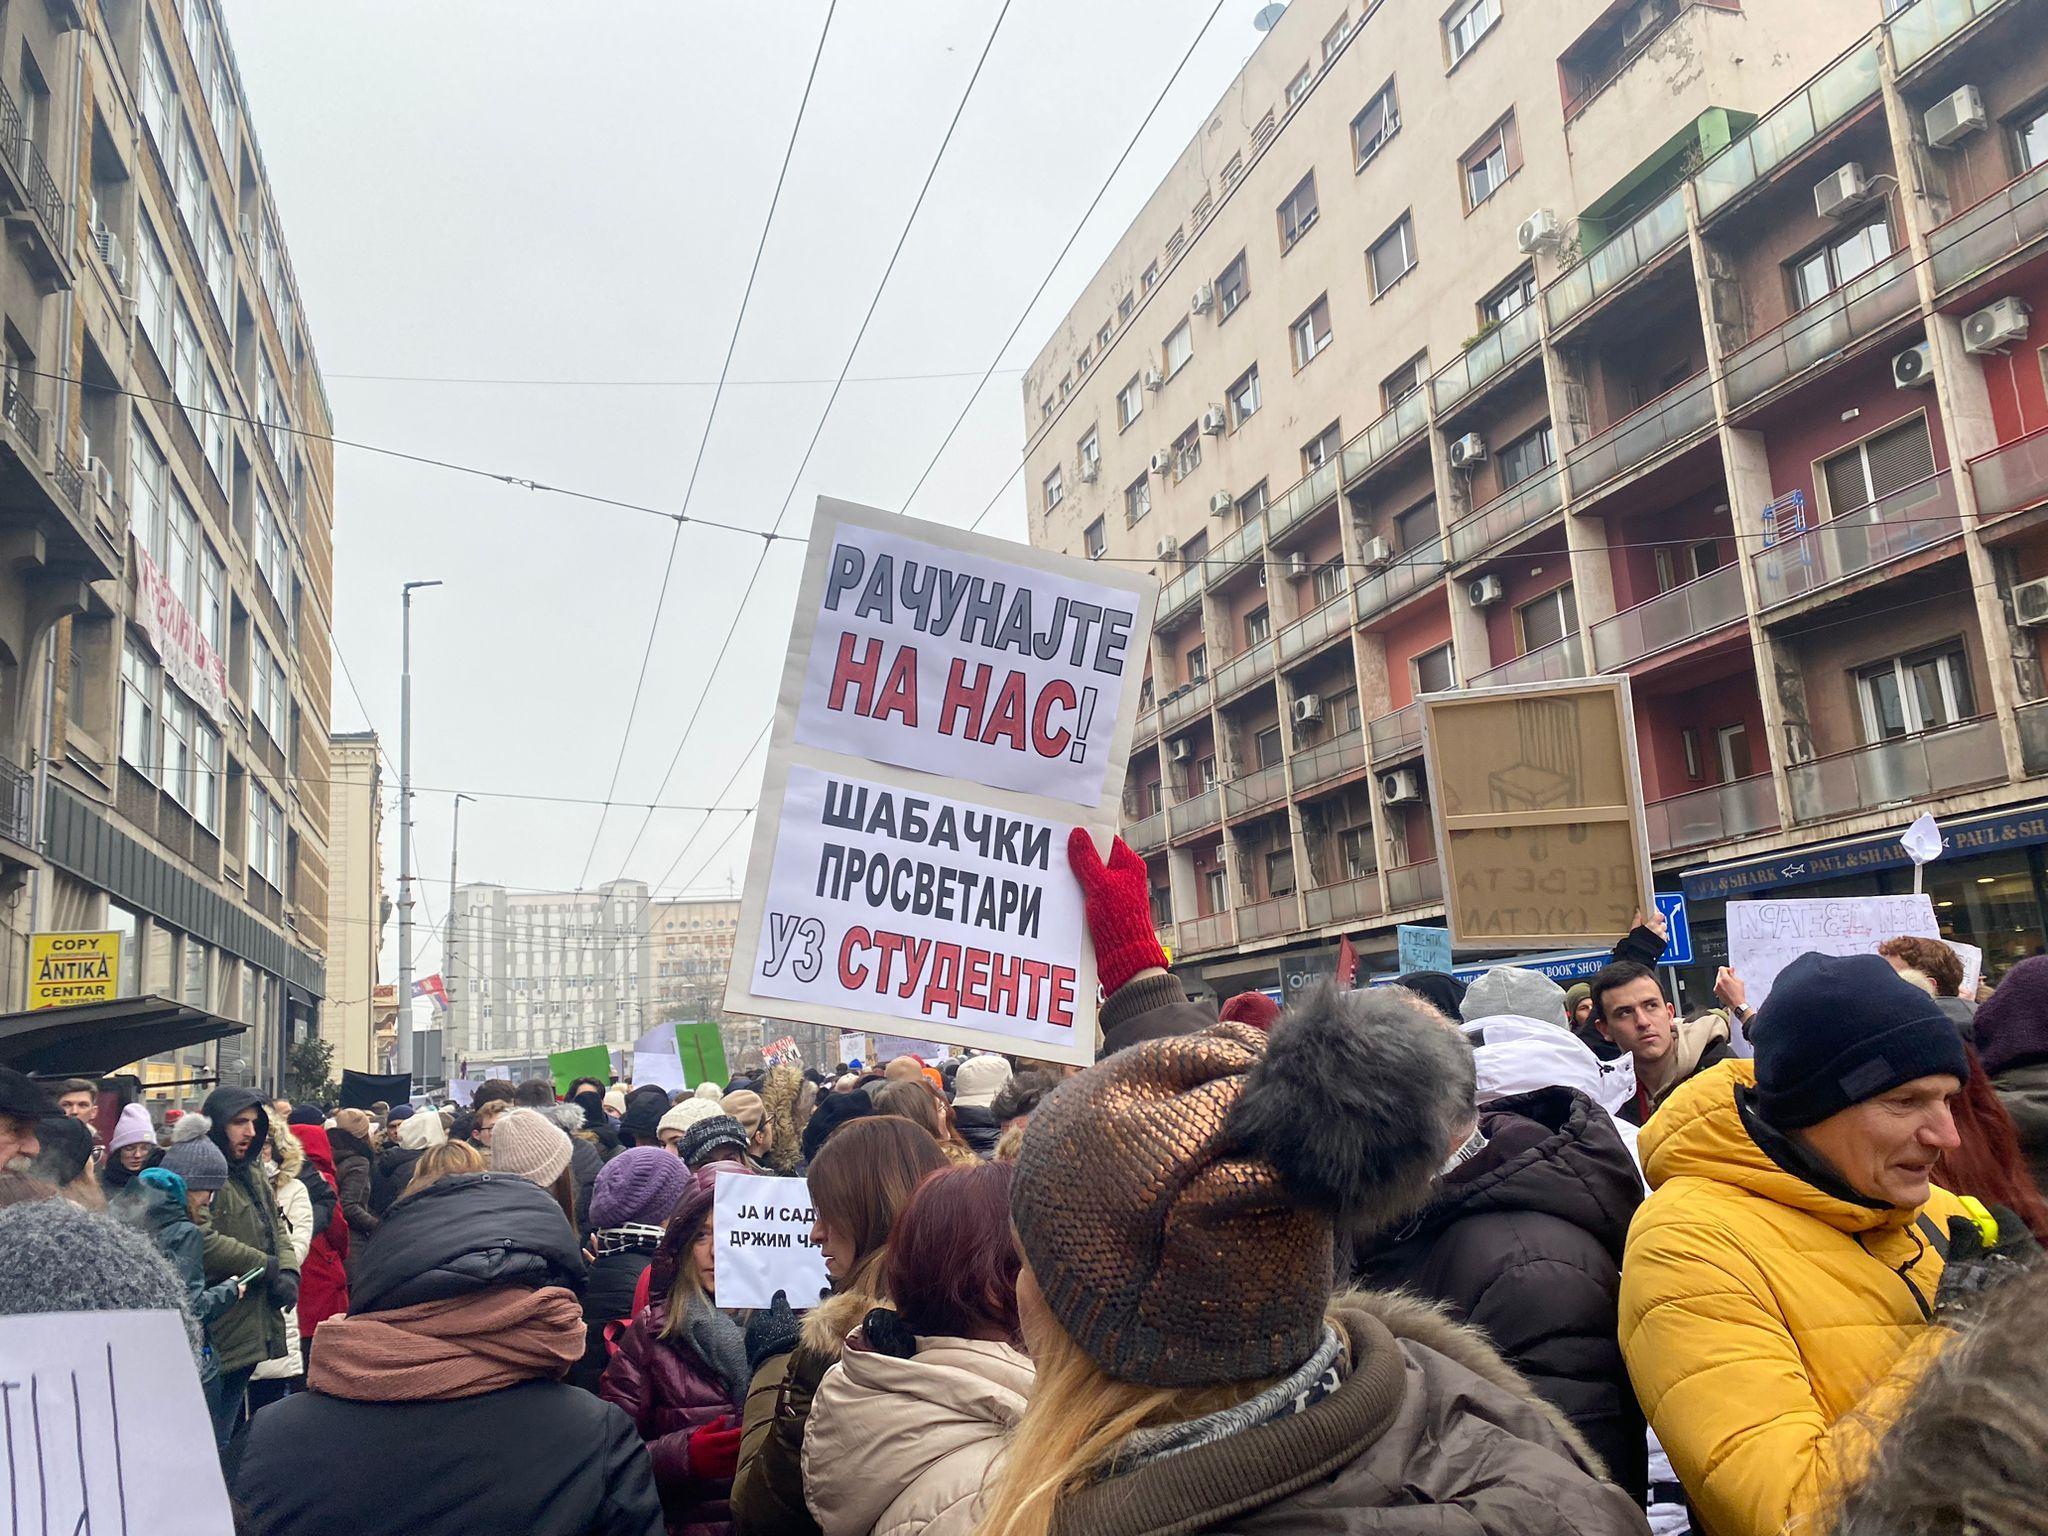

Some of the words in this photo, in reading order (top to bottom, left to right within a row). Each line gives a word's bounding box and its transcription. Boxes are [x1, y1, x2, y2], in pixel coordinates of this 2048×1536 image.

[824, 543, 1134, 676] РАЧУНАЈТЕ
[827, 631, 919, 728] НА
[937, 657, 1098, 763] НАС!
[821, 780, 1052, 871] ШАБАЧКИ
[1955, 828, 1999, 849] PAUL
[1809, 851, 1845, 874] PAUL
[1858, 843, 1908, 866] SHAR
[1730, 868, 1777, 888] SHARK
[815, 842, 1043, 939] ПРОСВЕТАРИ
[52, 939, 99, 950] COPY
[39, 952, 109, 980] ANTIKA
[762, 912, 825, 983] УЗ
[837, 925, 1076, 1027] СТУДЕНТЕ
[1577, 961, 1603, 975] SHOP
[41, 986, 105, 997] CENTAR
[737, 1204, 759, 1220] ЈА
[764, 1206, 774, 1221] И
[779, 1207, 816, 1225] САД
[730, 1230, 791, 1248] ДРЖИМ
